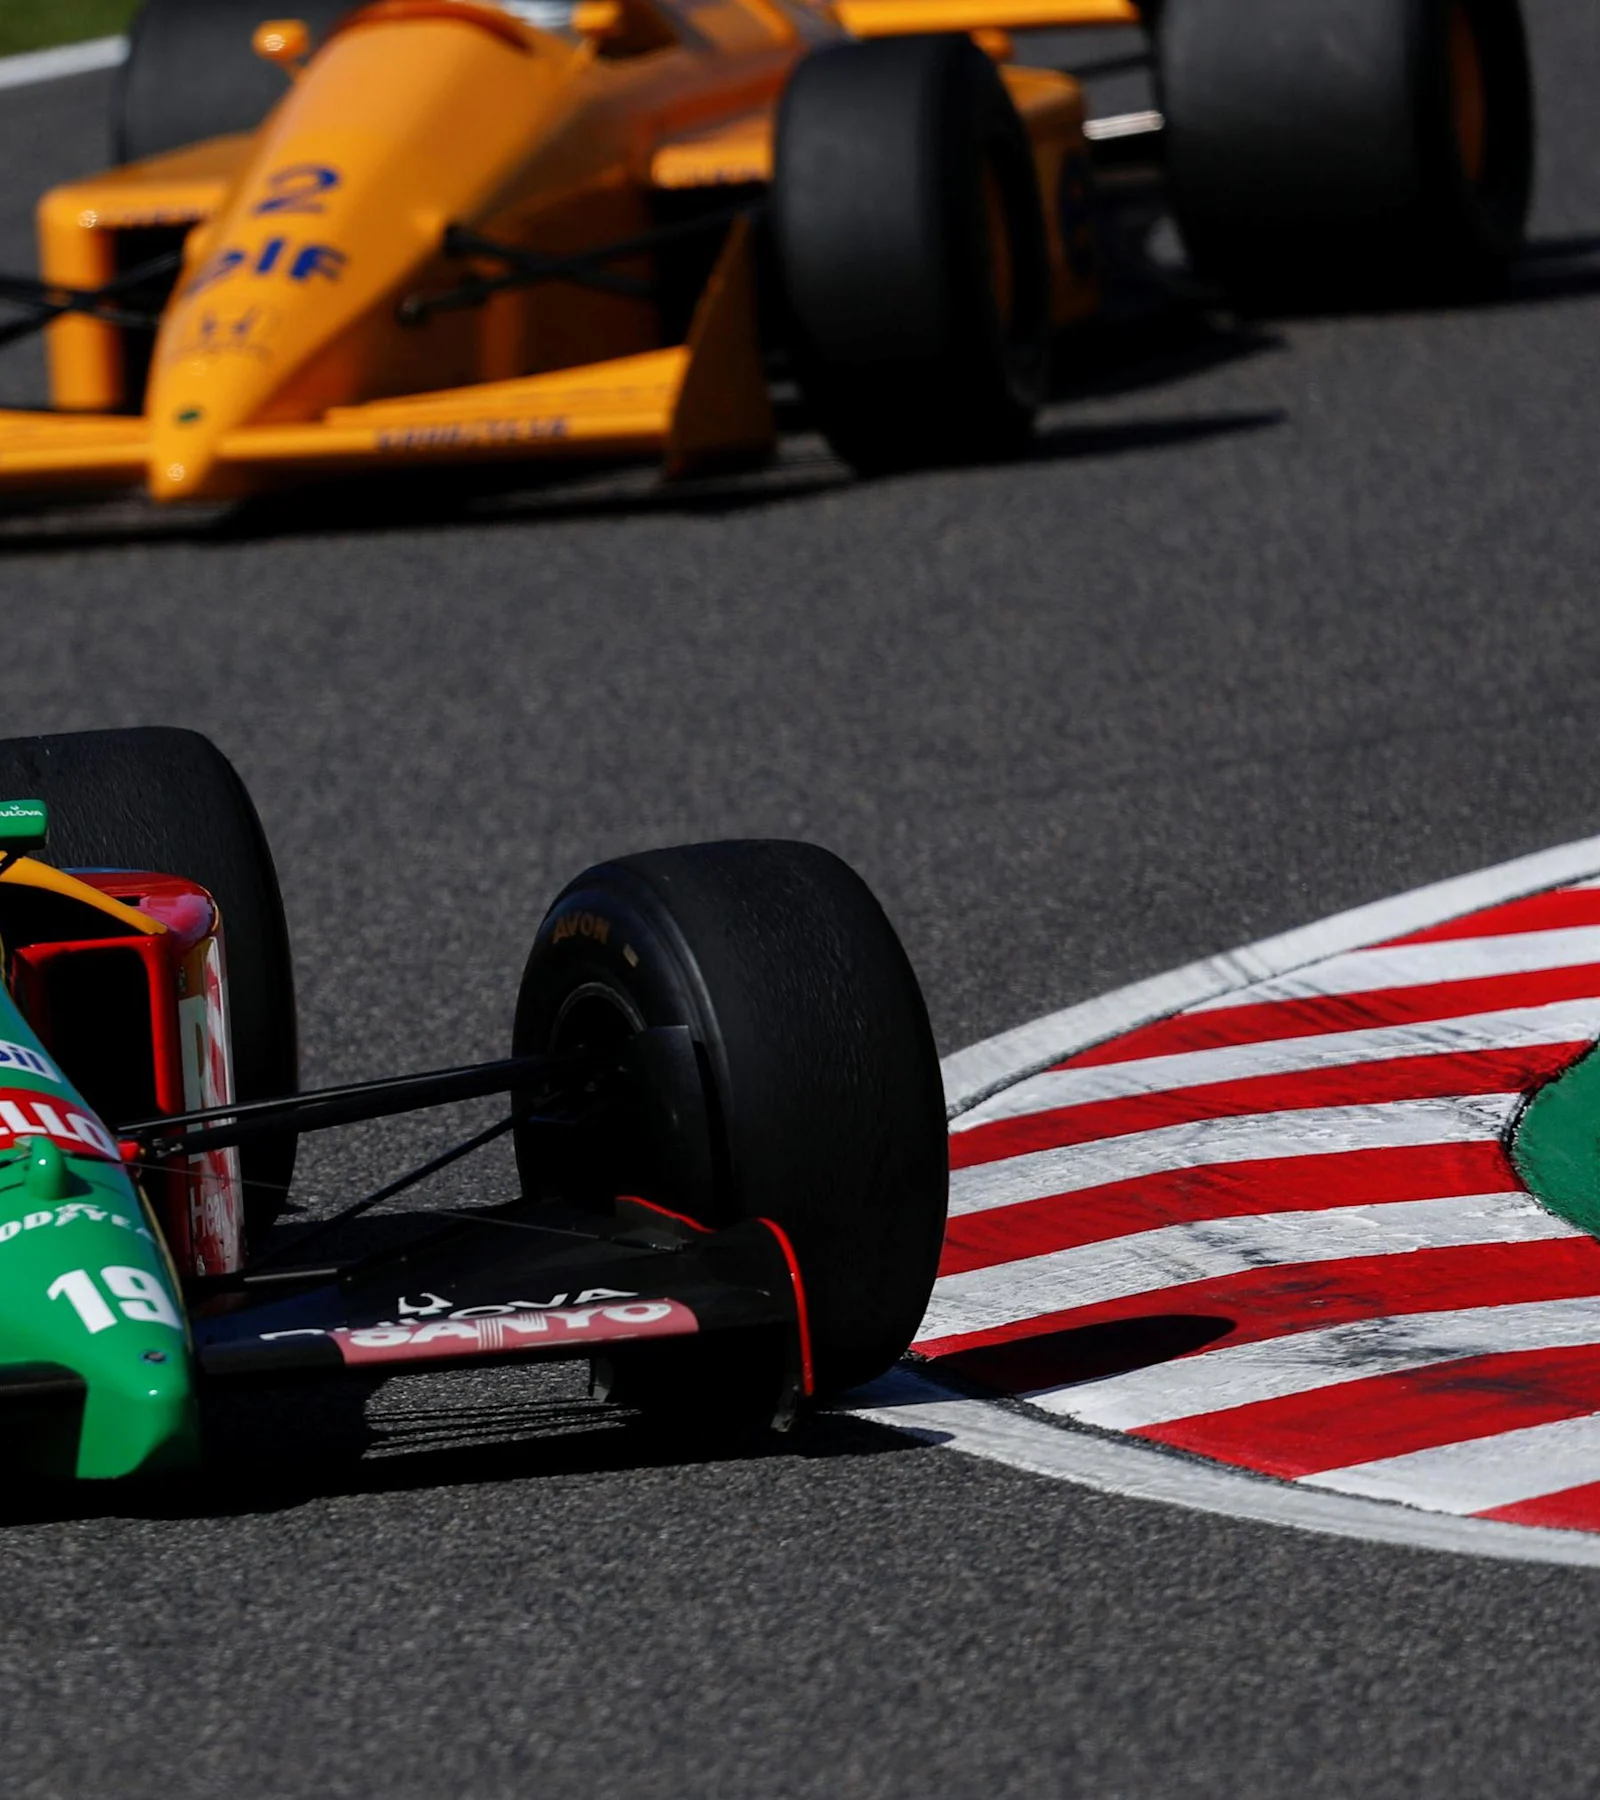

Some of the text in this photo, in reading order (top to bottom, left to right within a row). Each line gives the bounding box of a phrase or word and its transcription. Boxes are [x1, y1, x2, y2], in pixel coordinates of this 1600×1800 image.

[257, 164, 339, 215] 2
[553, 911, 610, 946] AVON
[47, 1265, 183, 1334] 19
[349, 1301, 674, 1351] SANYO
